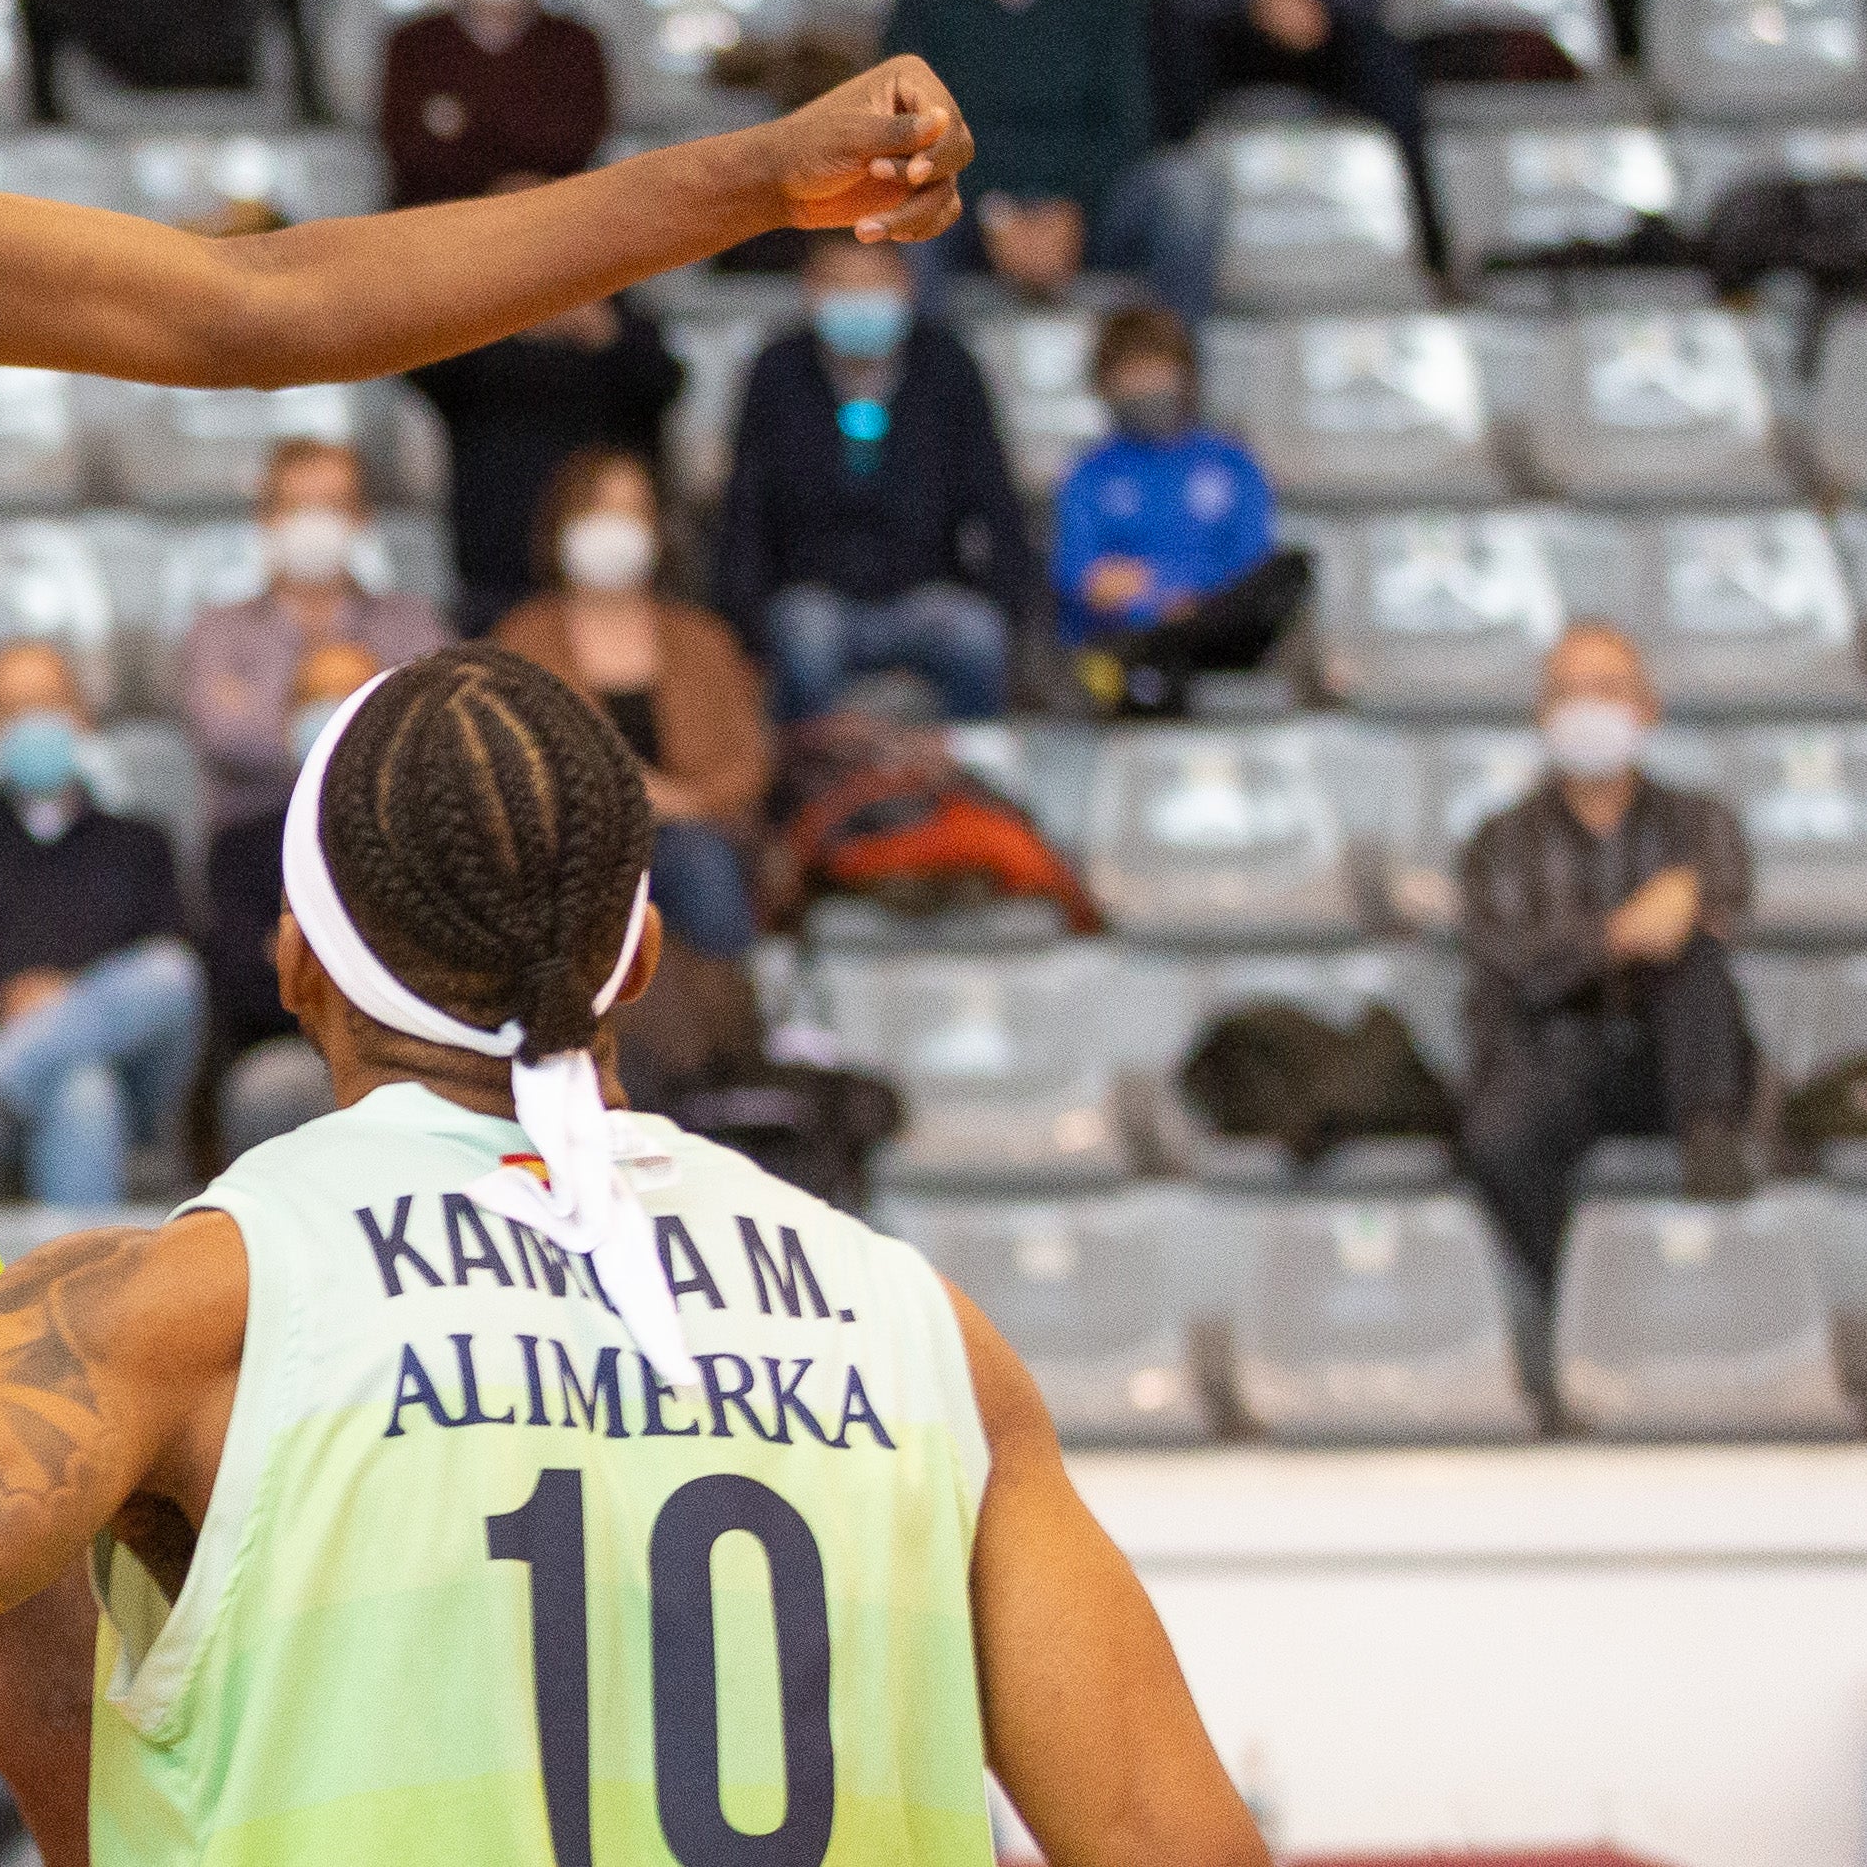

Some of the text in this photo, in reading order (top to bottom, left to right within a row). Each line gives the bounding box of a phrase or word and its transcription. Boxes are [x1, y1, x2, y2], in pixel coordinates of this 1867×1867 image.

[354, 1192, 857, 1323] KAMA M.
[382, 1332, 899, 1451] ALIMERKA
[486, 1467, 836, 1867] 10
